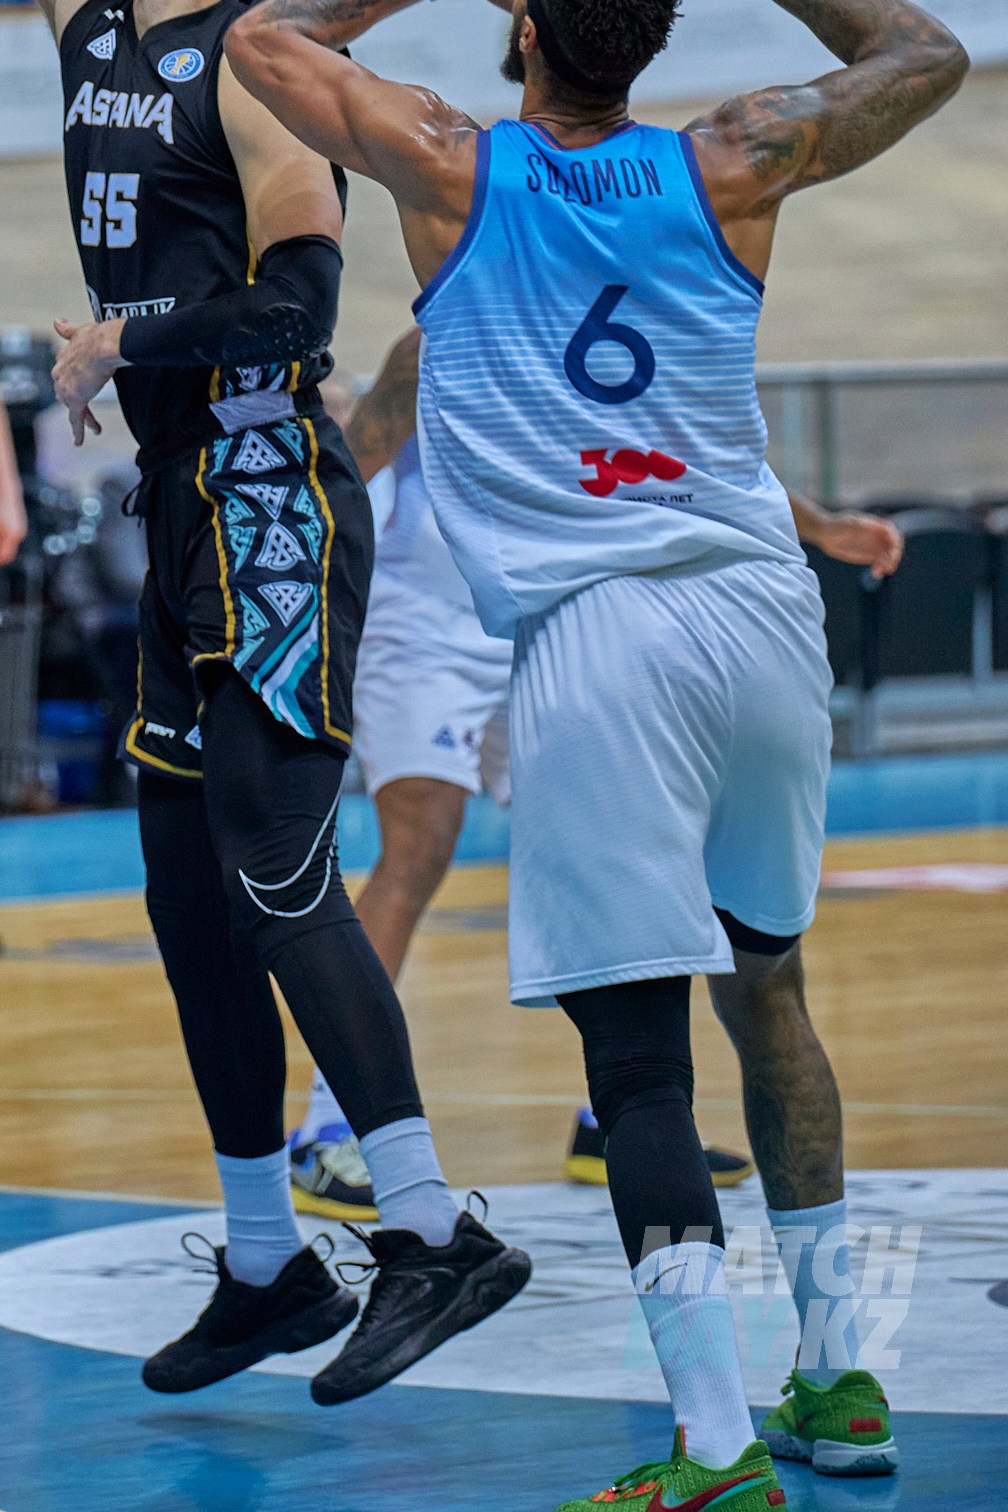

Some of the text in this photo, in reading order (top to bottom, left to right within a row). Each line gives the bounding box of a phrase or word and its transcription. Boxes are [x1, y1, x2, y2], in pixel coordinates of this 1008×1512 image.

[80, 172, 140, 248] 55
[527, 153, 663, 206] SOLOMON
[564, 285, 656, 405] 6
